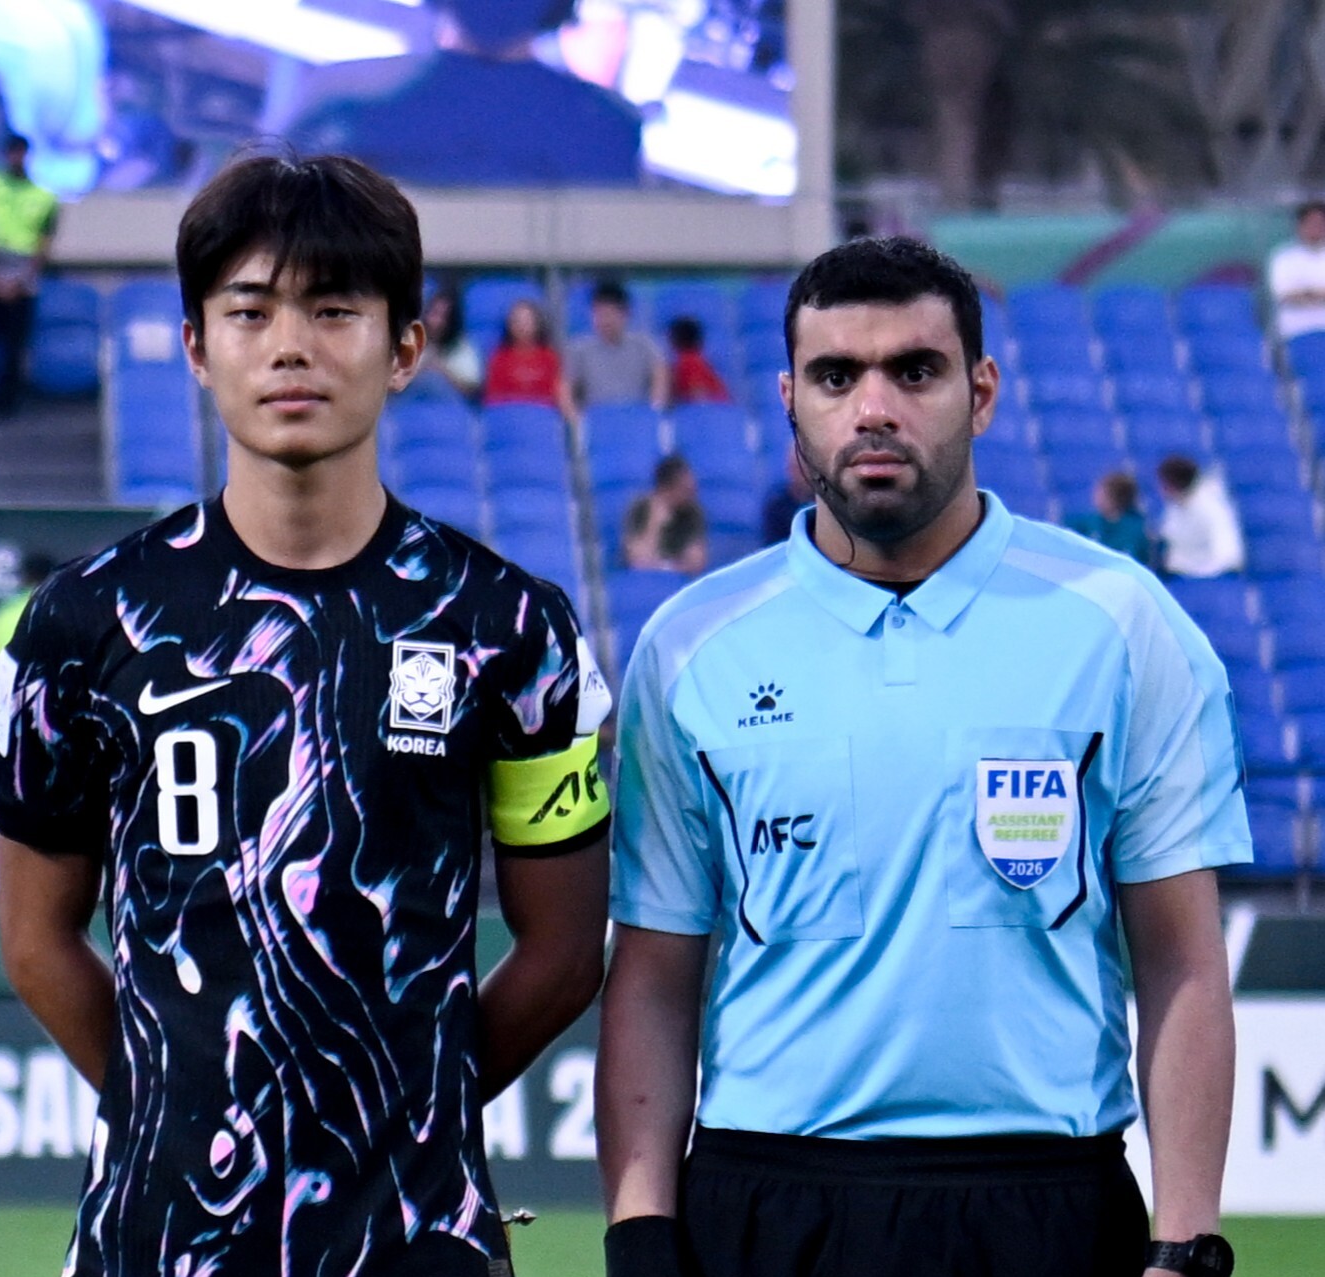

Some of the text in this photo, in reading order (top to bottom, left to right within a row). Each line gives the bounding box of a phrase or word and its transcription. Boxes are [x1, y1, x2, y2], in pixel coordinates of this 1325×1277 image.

[737, 712, 795, 728] KELME
[386, 735, 446, 758] KOREA
[154, 729, 219, 856] 8
[987, 769, 1068, 799] FIFA
[987, 813, 1066, 826] ASSISTANT
[750, 814, 817, 855] AFC
[993, 828, 1060, 842] REFEREE
[1007, 861, 1044, 877] 2026
